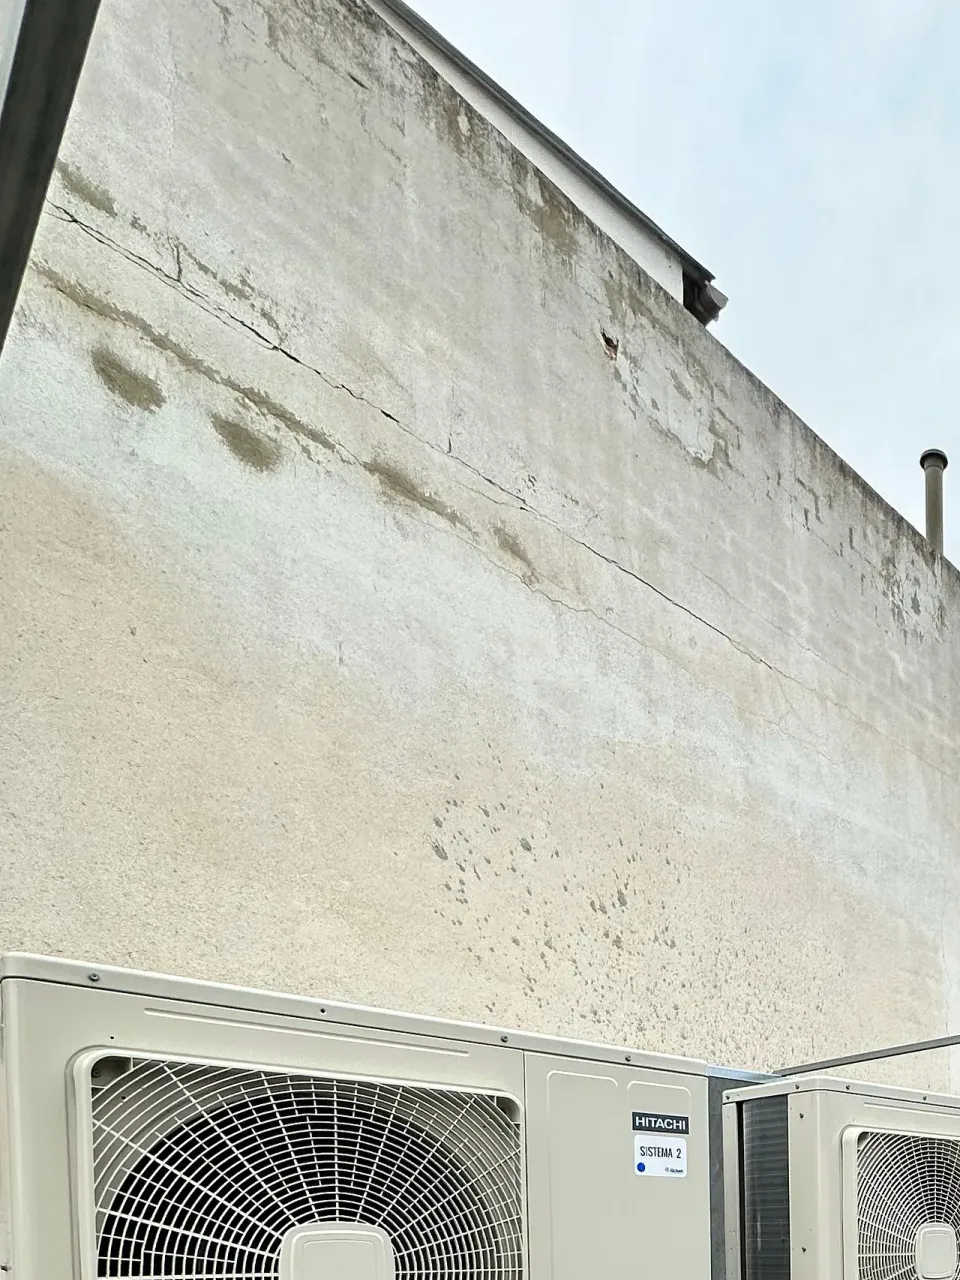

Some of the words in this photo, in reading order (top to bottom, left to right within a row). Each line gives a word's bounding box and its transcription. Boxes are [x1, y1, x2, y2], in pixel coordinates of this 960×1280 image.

[635, 1116, 686, 1130] HITACHI
[640, 1146, 673, 1158] SISTEMA
[676, 1148, 682, 1158] 2
